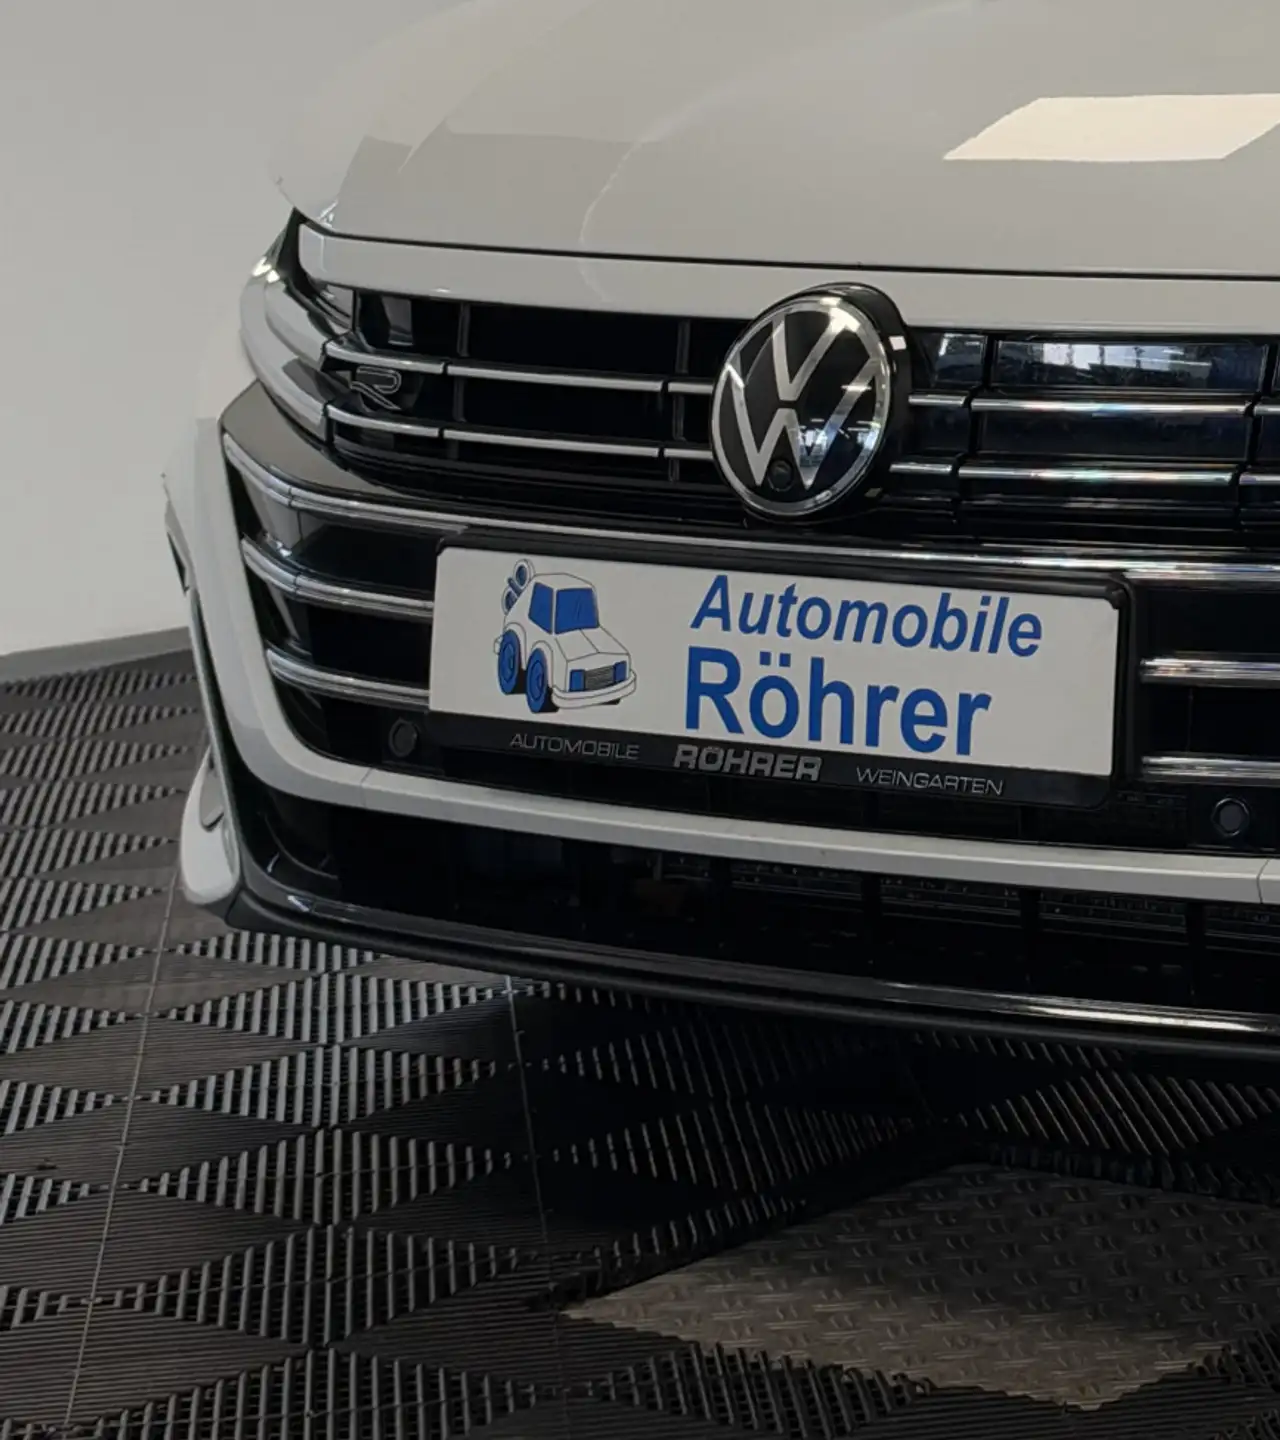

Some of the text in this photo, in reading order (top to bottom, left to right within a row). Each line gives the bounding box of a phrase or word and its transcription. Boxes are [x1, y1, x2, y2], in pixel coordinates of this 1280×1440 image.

[691, 574, 1044, 658] Automobile
[684, 646, 992, 757] Röhrer
[509, 733, 1005, 796] AUTOMOBILE RÖHRER WEINGARTEN
